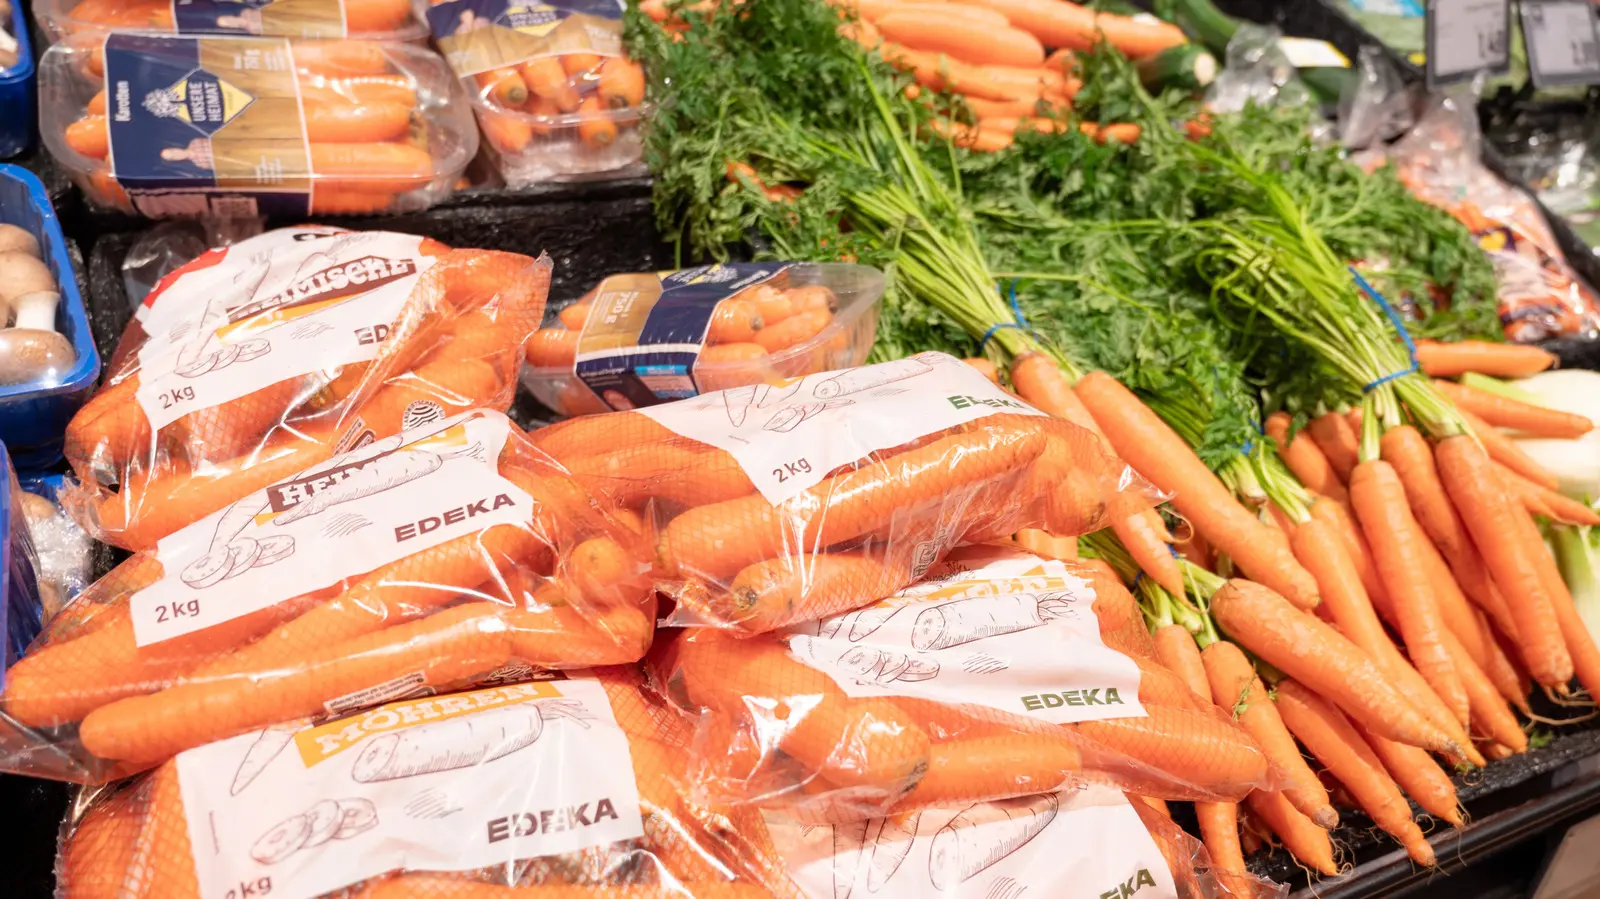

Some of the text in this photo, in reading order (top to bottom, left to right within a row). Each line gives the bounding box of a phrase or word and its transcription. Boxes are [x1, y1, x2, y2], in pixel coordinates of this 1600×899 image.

[189, 82, 206, 122] UNSERE
[204, 82, 222, 122] HEIMAT
[394, 493, 517, 543] EDEKA
[315, 683, 541, 755] MÖHREN
[1021, 687, 1125, 712] EDEKA
[487, 797, 620, 844] EDEKA
